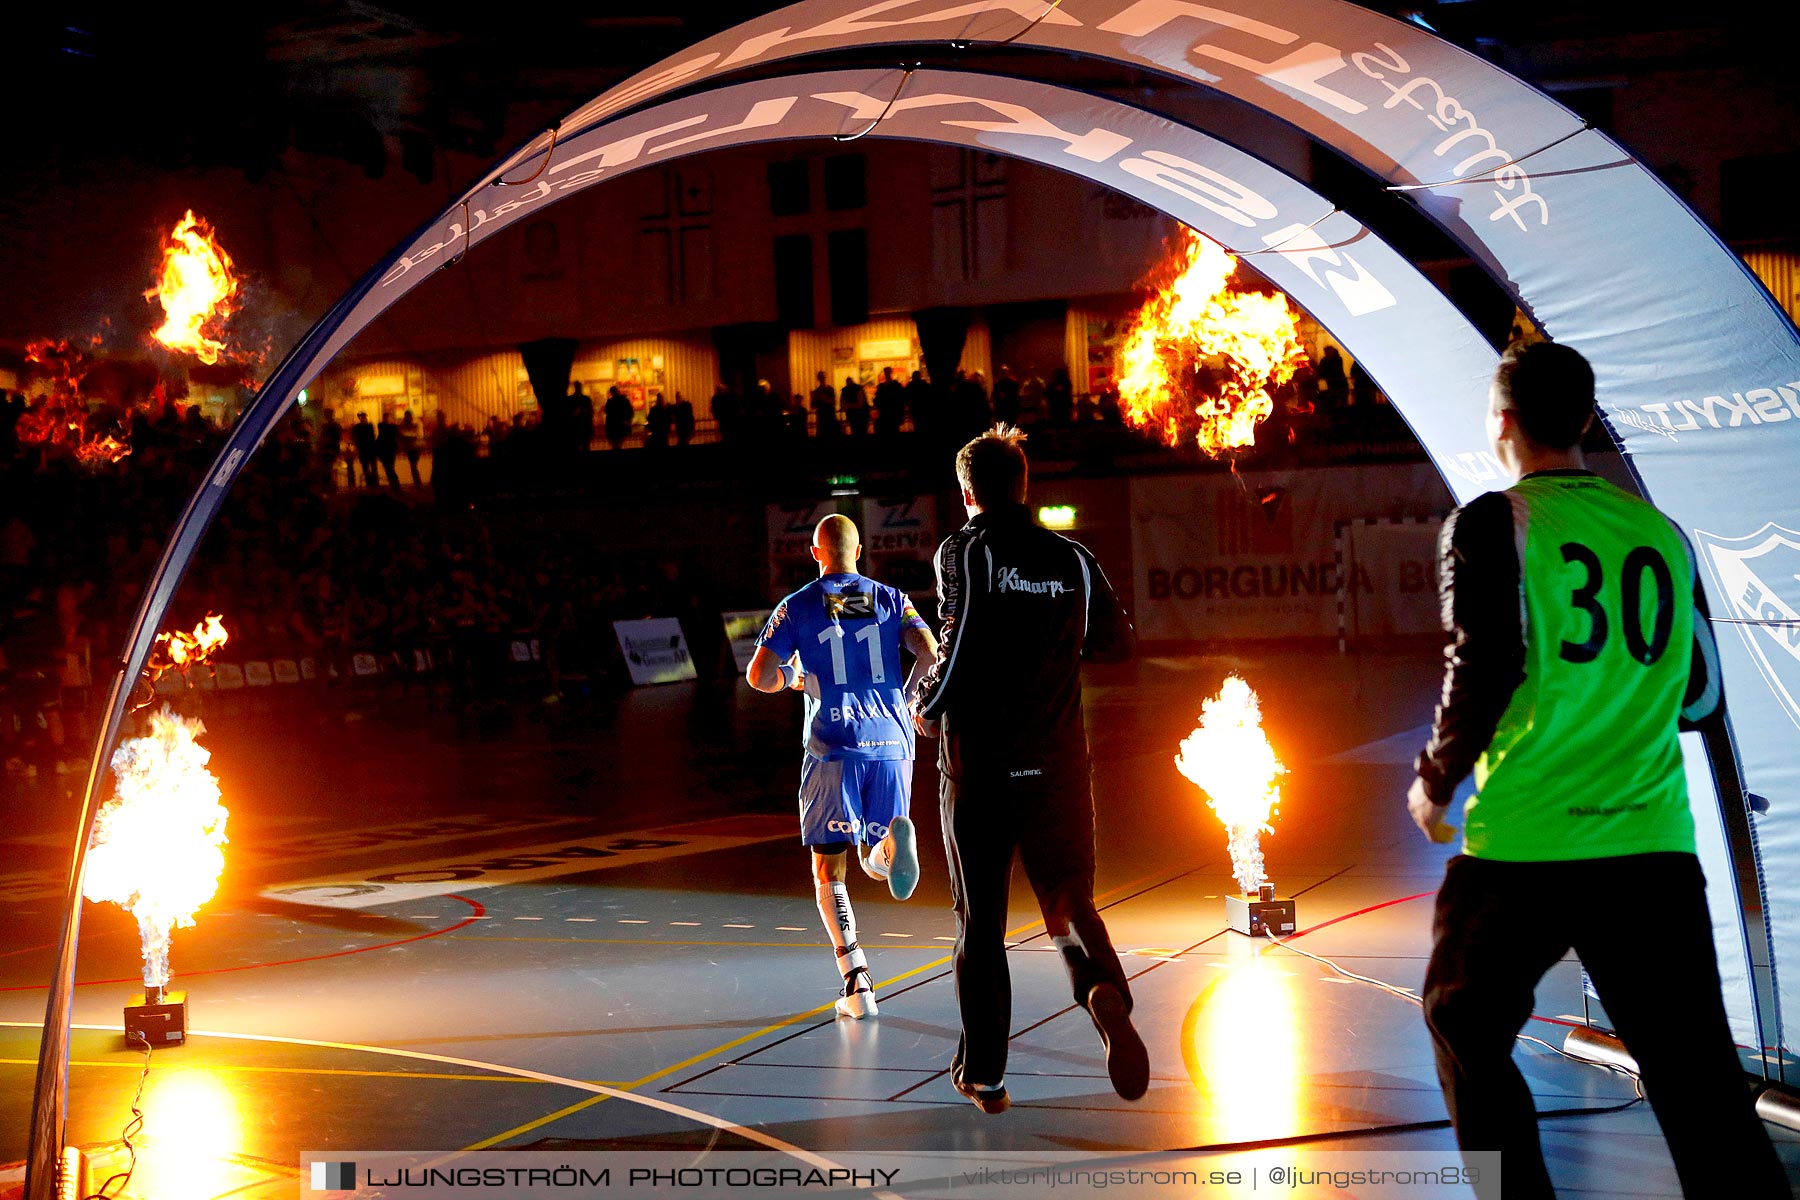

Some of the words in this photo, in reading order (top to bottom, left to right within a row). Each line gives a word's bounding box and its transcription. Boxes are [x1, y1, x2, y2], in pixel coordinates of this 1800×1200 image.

[1148, 560, 1374, 601] BORGUNDA
[1558, 543, 1674, 665] 30
[817, 624, 886, 685] 11
[1009, 768, 1043, 778] SALMING
